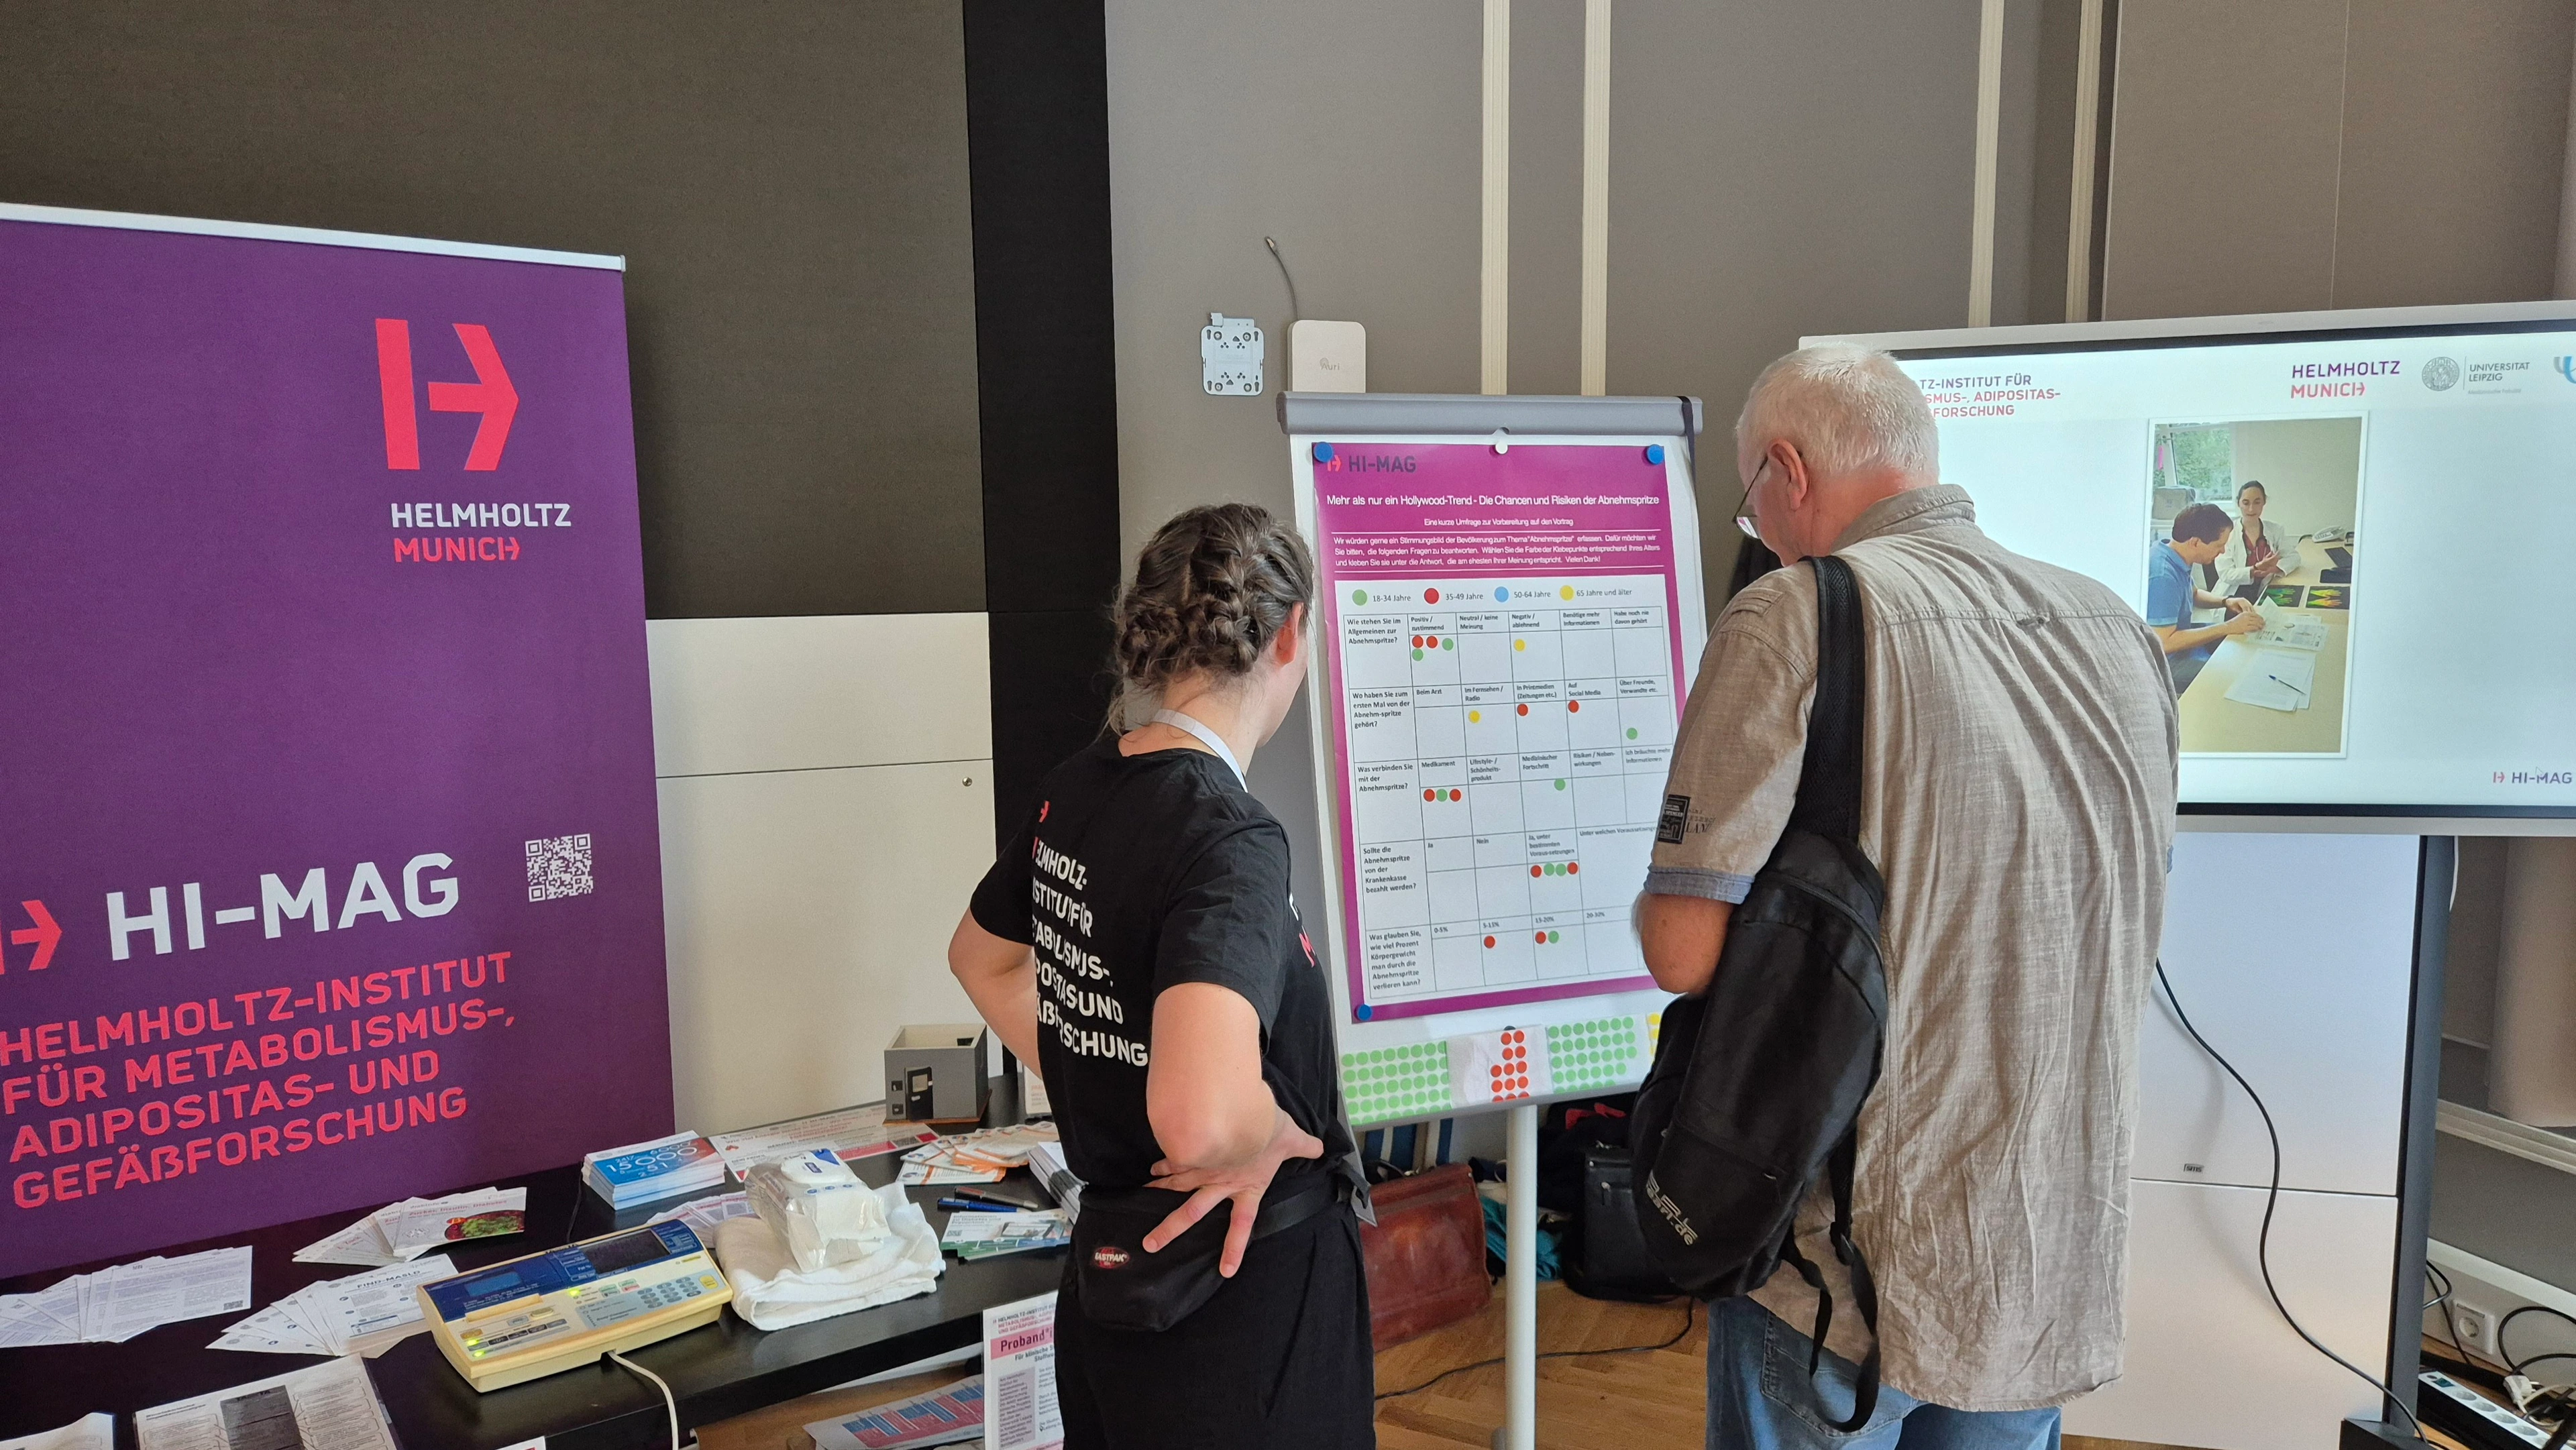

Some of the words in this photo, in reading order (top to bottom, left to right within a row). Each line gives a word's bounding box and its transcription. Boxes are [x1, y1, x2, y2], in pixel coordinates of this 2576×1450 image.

[1321, 362, 1339, 370] Auri
[2292, 361, 2400, 379] HELMHOLTZ
[1920, 376, 2001, 389] TZ-INSTITUT
[2006, 374, 2031, 386] FÜR
[2469, 373, 2502, 382] LEIPZIG
[1974, 389, 2061, 402] ADIPOSITAS-
[2291, 382, 2365, 398] MUNICH
[1933, 405, 2015, 417] FORSCHUNG
[1349, 455, 1415, 473] HI-MAG
[1327, 495, 1350, 506] Mehr
[1352, 495, 1365, 506] als
[1368, 497, 1382, 506] nur
[1385, 495, 1398, 505] ein
[1401, 494, 1472, 508] Hollywood-Trend
[1479, 496, 1493, 504] Die
[1495, 496, 1532, 504] Chancen
[1534, 496, 1549, 504] und
[1552, 496, 1581, 504] Risiken
[1583, 495, 1597, 504] der
[1598, 494, 1659, 506] Abnehmspritze
[391, 502, 572, 528] HELMHOLTZ
[394, 537, 521, 563] MUNICH
[1410, 548, 1432, 556] Fragen
[1354, 721, 1377, 729] gehört?
[2512, 772, 2572, 783] HI-MAG
[1359, 783, 1407, 792] Abnehmspritze?
[1364, 855, 1410, 865] Abnehmspritze
[1365, 875, 1407, 884] Krankenkasse
[1366, 885, 1388, 893] bezahlt
[1390, 883, 1416, 891] werden?
[106, 852, 459, 960] HI-MAG
[1385, 932, 1409, 940] glauben
[1395, 940, 1419, 948] Prozent
[1371, 950, 1416, 960] Körpergewicht
[1373, 970, 1419, 981] Abnehmspritze
[1373, 981, 1401, 990] verlieren
[1402, 979, 1420, 987] kann?
[0, 952, 513, 1066] HELMHOLTZ-INSTITUT
[1079, 991, 1124, 1024] UND
[2, 1063, 106, 1114] FÜR
[125, 999, 516, 1093] METABOLISMUS-,
[9, 1075, 335, 1162] ADIPOSITAS-
[349, 1050, 440, 1095] UND
[356, 1270, 421, 1288] FIND-MASLD
